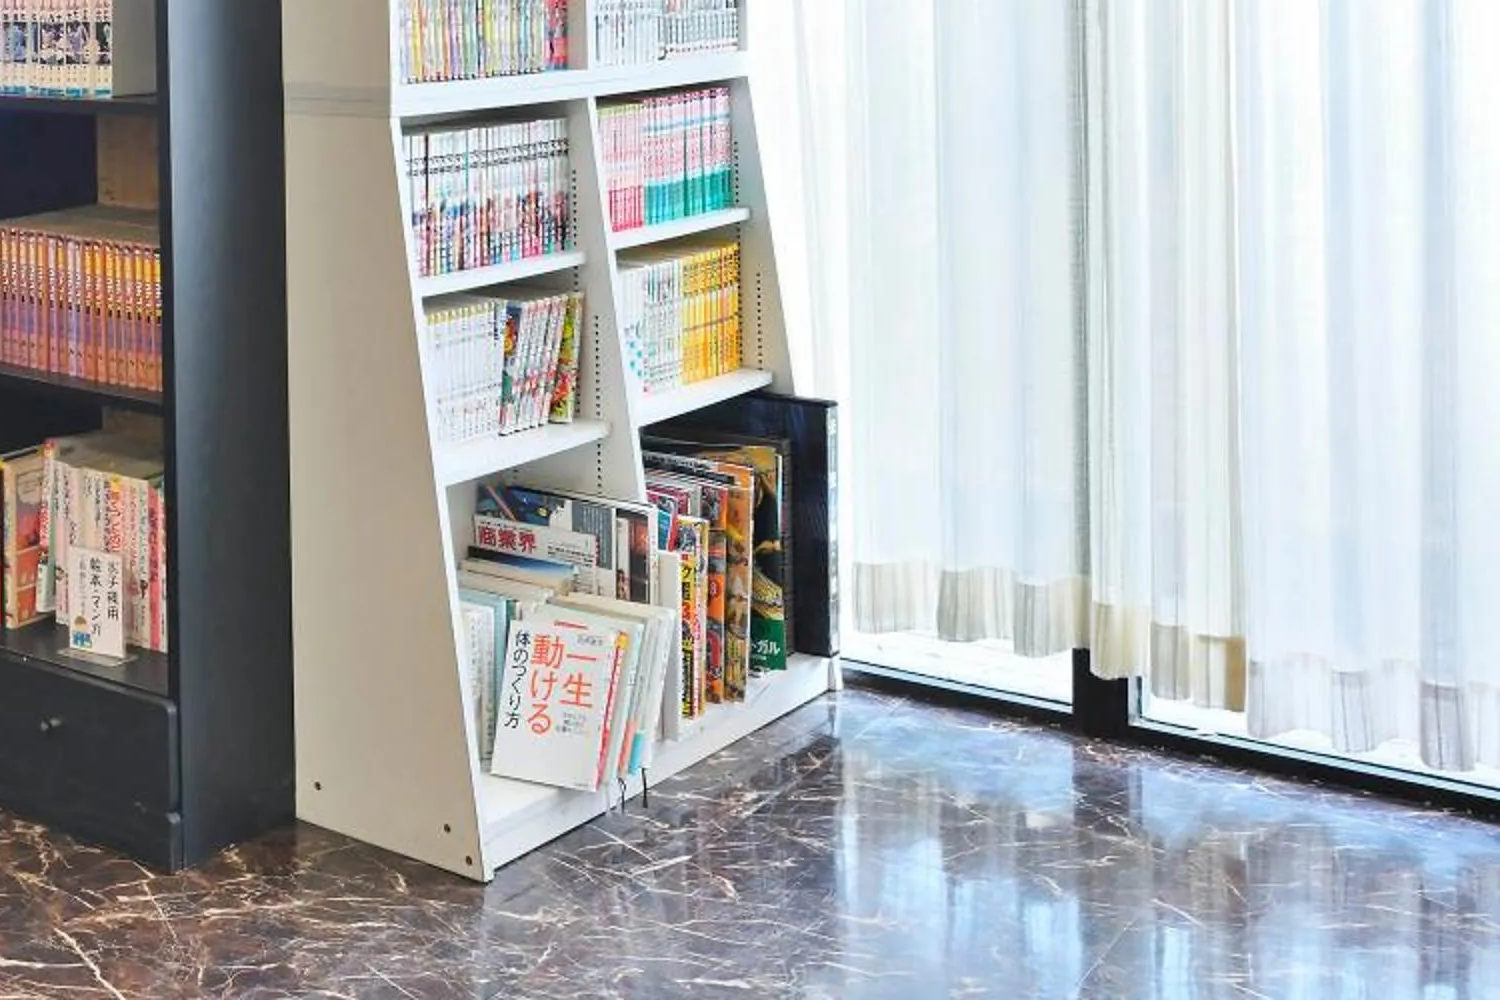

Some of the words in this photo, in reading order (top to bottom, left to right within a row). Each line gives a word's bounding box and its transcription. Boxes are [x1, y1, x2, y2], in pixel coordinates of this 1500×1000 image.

[478, 525, 537, 554] 商業界
[503, 630, 532, 730] 体のつくり方
[527, 633, 565, 736] 動ける
[559, 652, 598, 709] 一生
